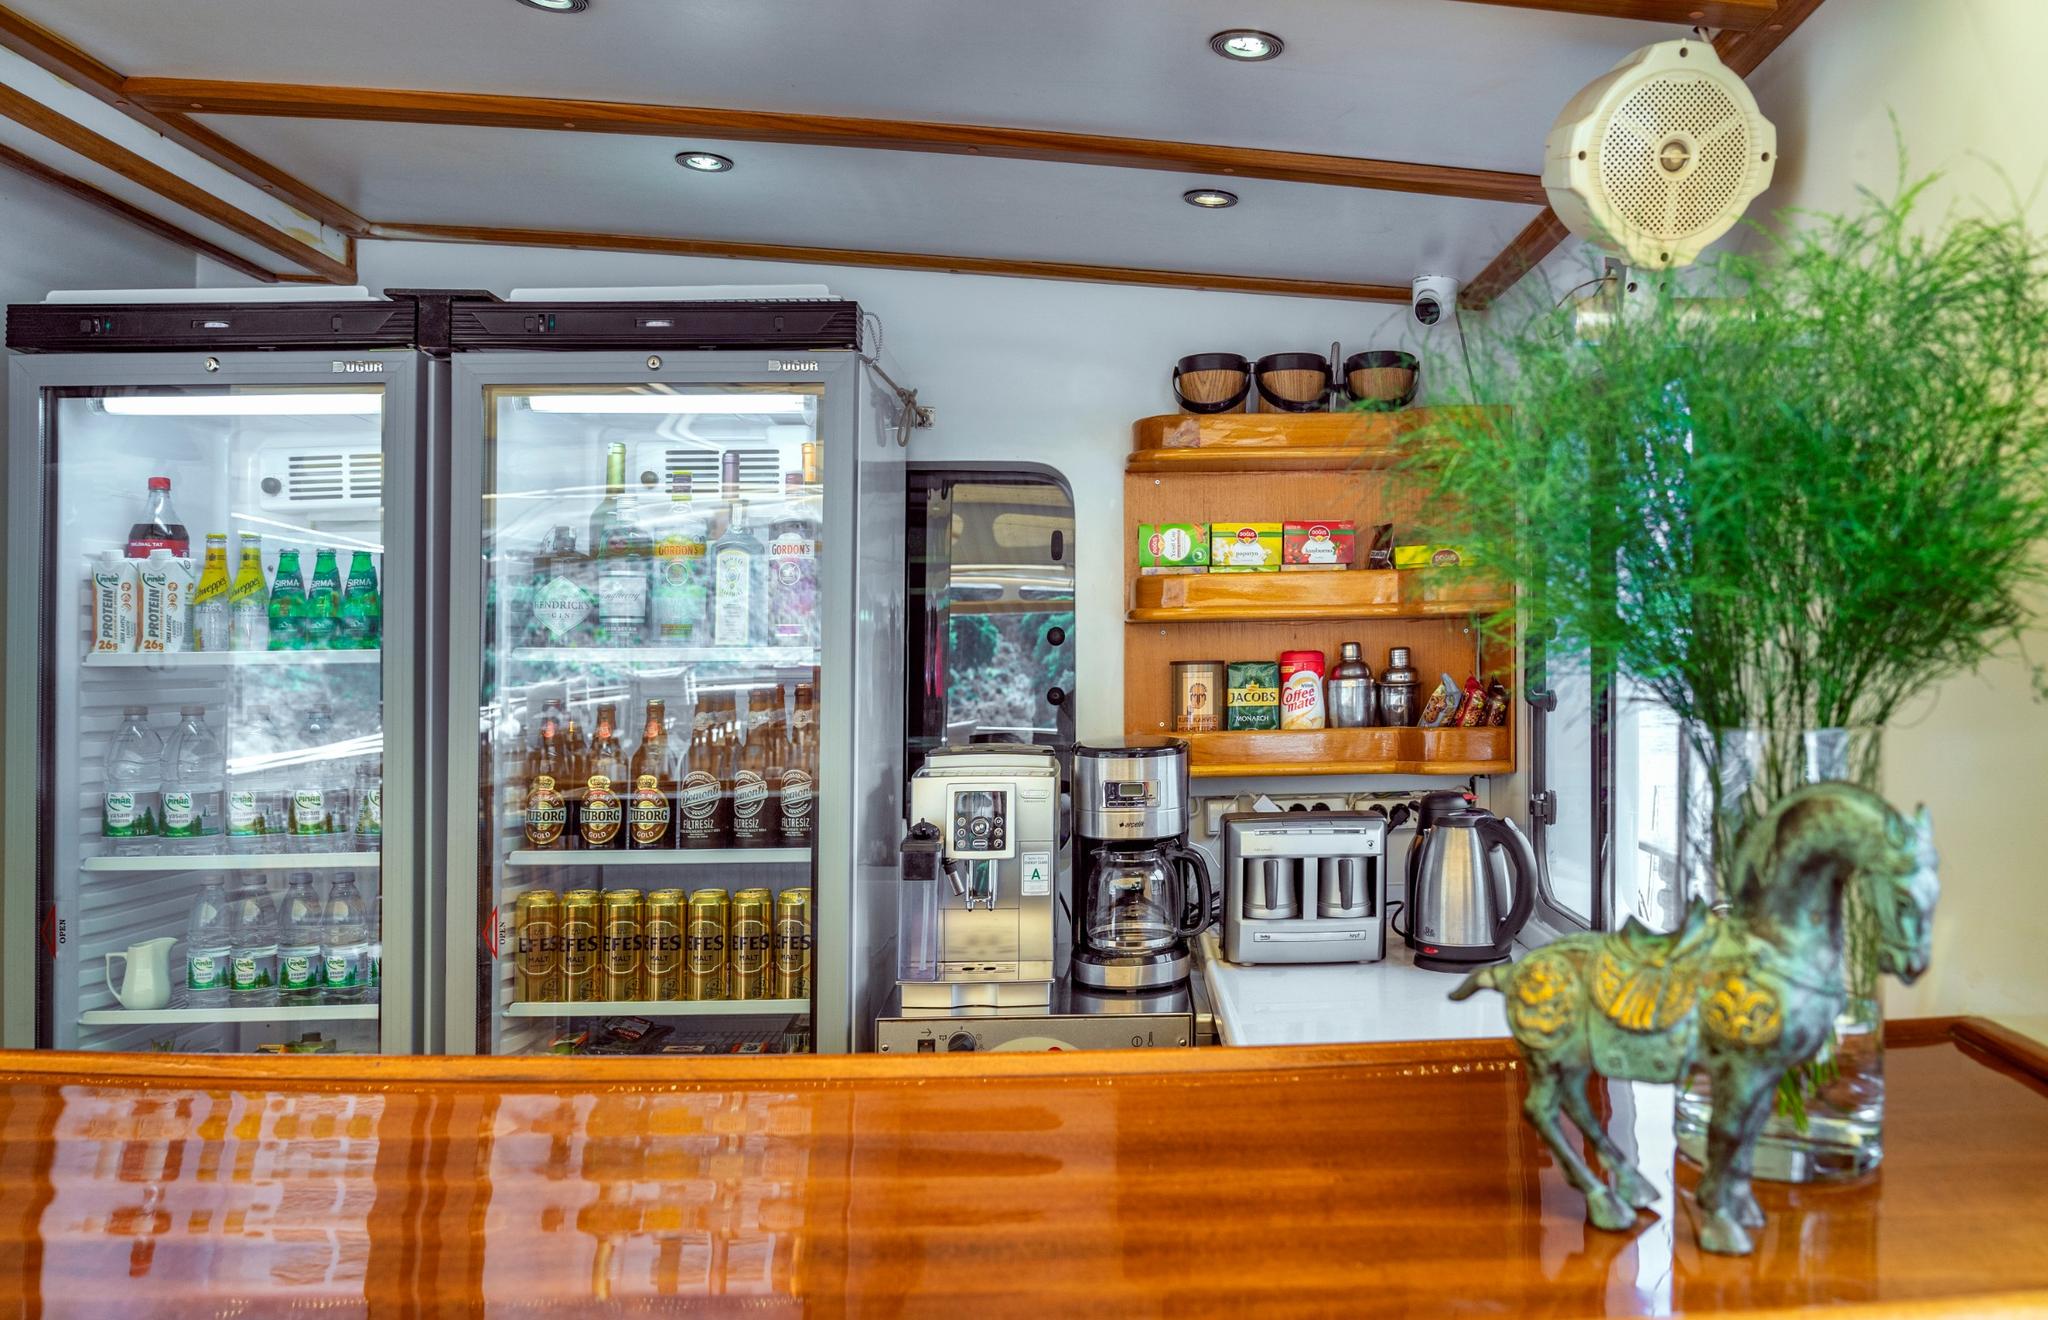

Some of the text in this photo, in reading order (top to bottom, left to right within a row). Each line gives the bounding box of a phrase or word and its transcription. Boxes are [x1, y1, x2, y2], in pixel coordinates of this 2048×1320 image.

[275, 579, 299, 588] SIRMA
[311, 579, 334, 588] SIRMA
[347, 578, 371, 588] SIRMA
[1230, 692, 1276, 704] JACOBS
[1282, 687, 1315, 706] Coffee
[1288, 698, 1315, 713] mate
[581, 810, 620, 821] TUBORG
[532, 831, 551, 839] GOLD
[588, 831, 607, 839] GOLD
[636, 830, 655, 838] GOLD
[1031, 868, 1041, 880] A
[559, 935, 598, 952] EFES
[602, 934, 642, 952] EFES
[732, 933, 770, 951] EFES
